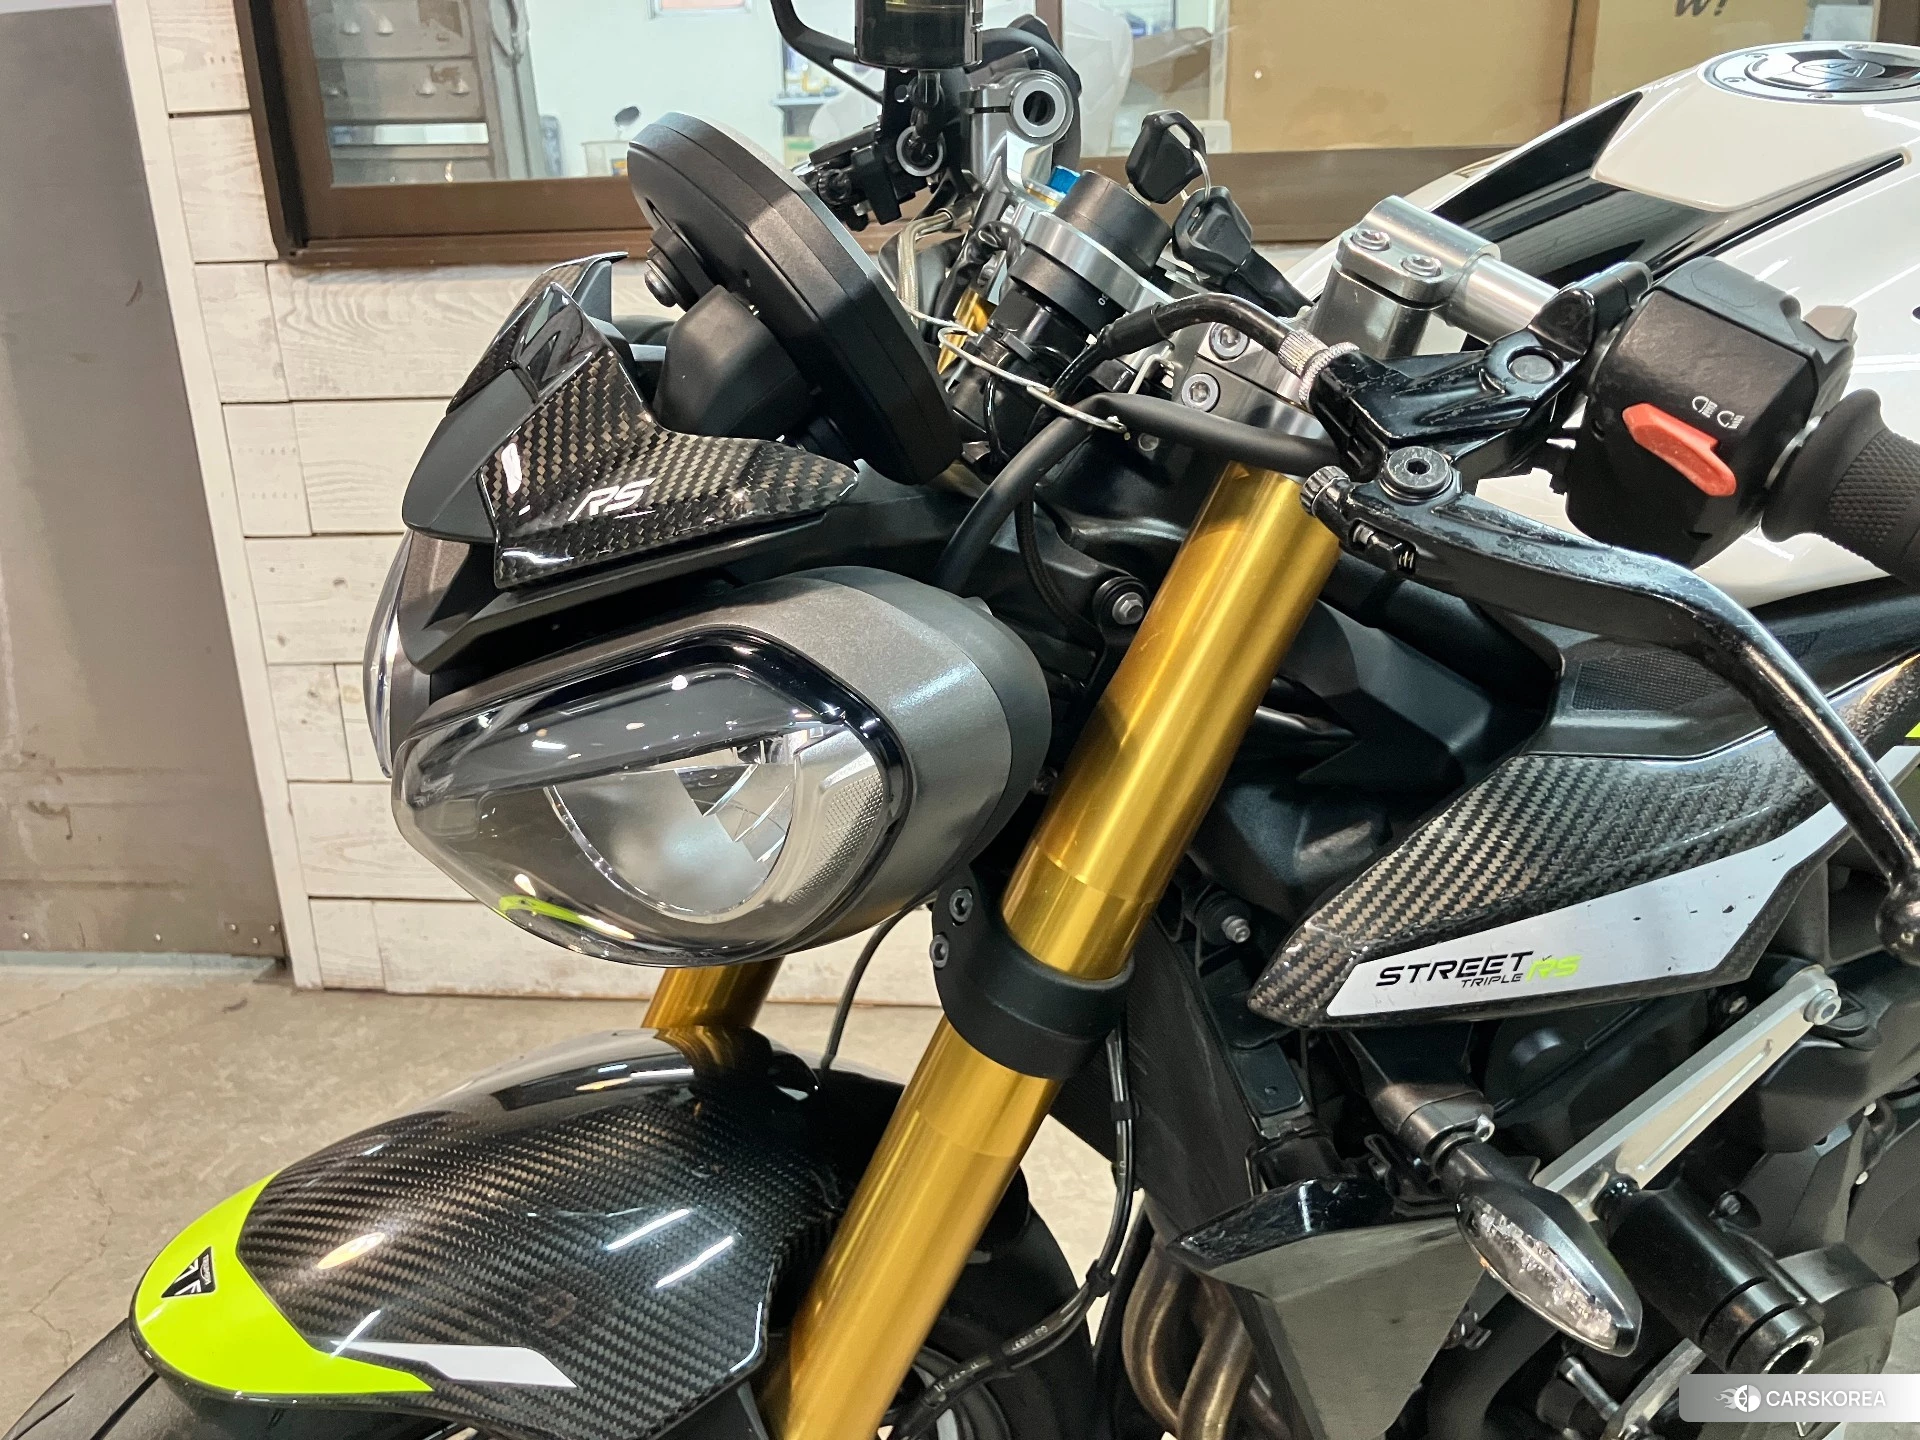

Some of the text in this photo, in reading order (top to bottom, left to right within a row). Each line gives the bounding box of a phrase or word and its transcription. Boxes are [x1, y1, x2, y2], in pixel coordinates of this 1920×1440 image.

[567, 477, 657, 521] RS
[1375, 950, 1583, 986] STREET RS
[1460, 972, 1524, 989] TRIPLE
